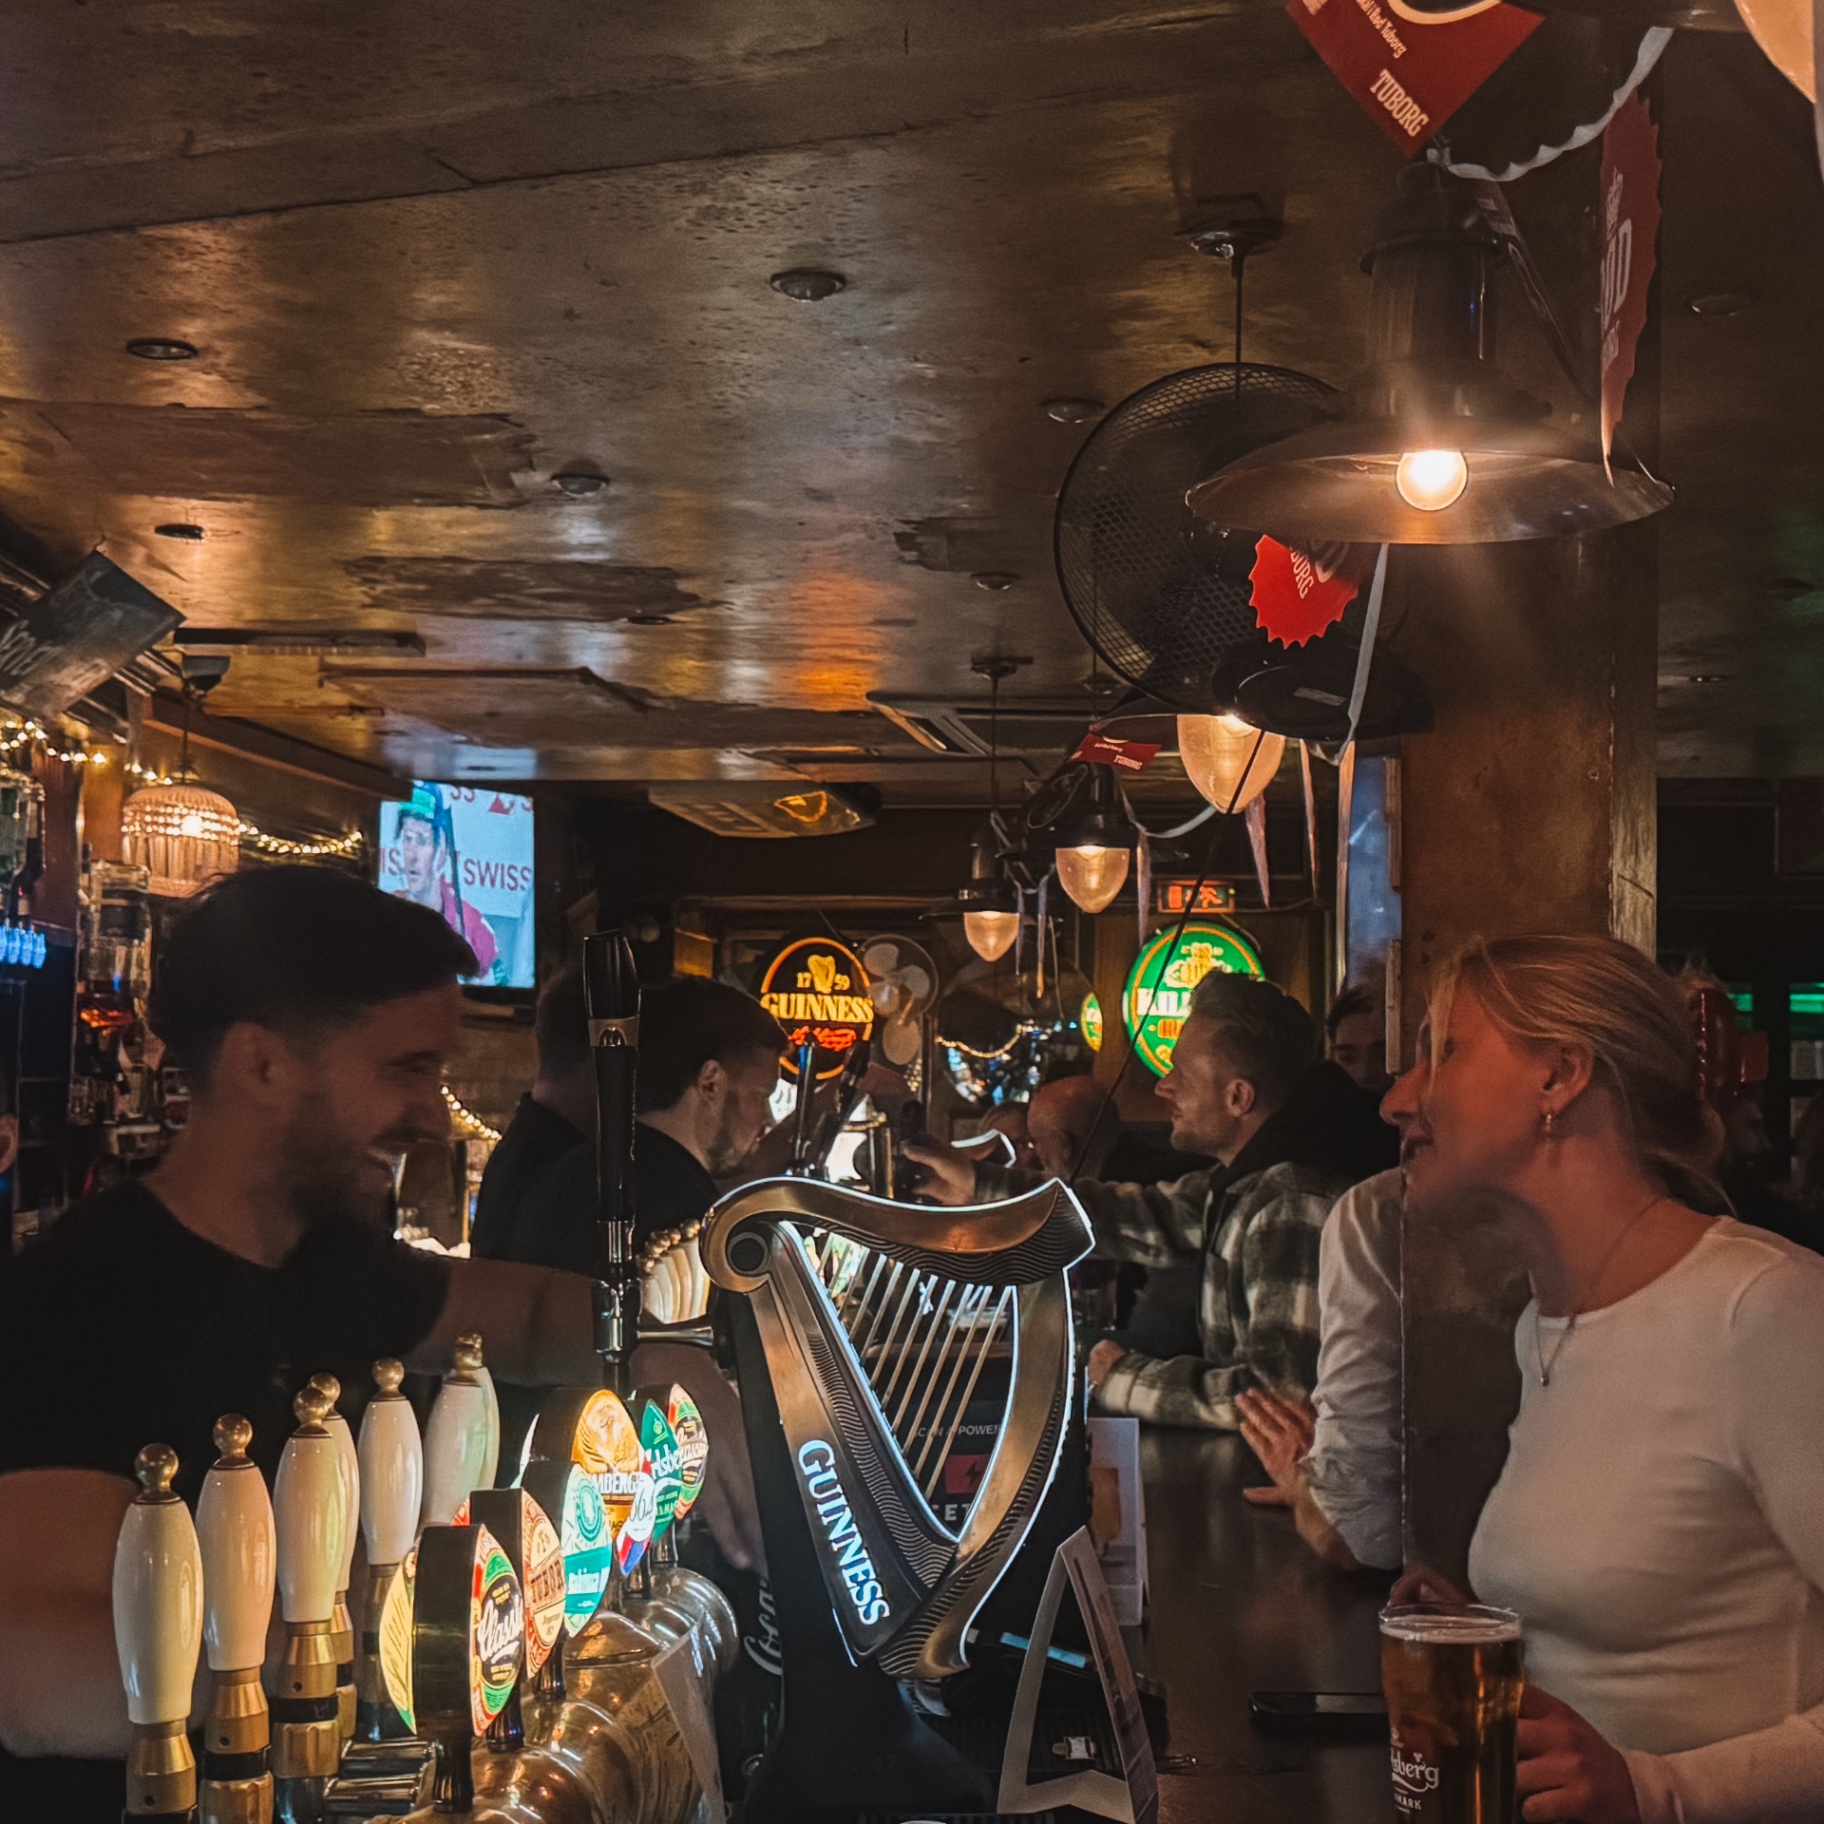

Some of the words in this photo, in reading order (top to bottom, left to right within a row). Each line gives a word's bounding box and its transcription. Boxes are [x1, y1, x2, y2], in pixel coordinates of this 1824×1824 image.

[1381, 20, 1407, 58] Tuborg
[1369, 68, 1430, 137] TUBORG
[796, 972, 812, 988] 17
[834, 973, 850, 991] 59
[760, 993, 875, 1023] GUINNESS
[799, 1439, 891, 1626] GUINNESS
[530, 1556, 565, 1603] TUBOR
